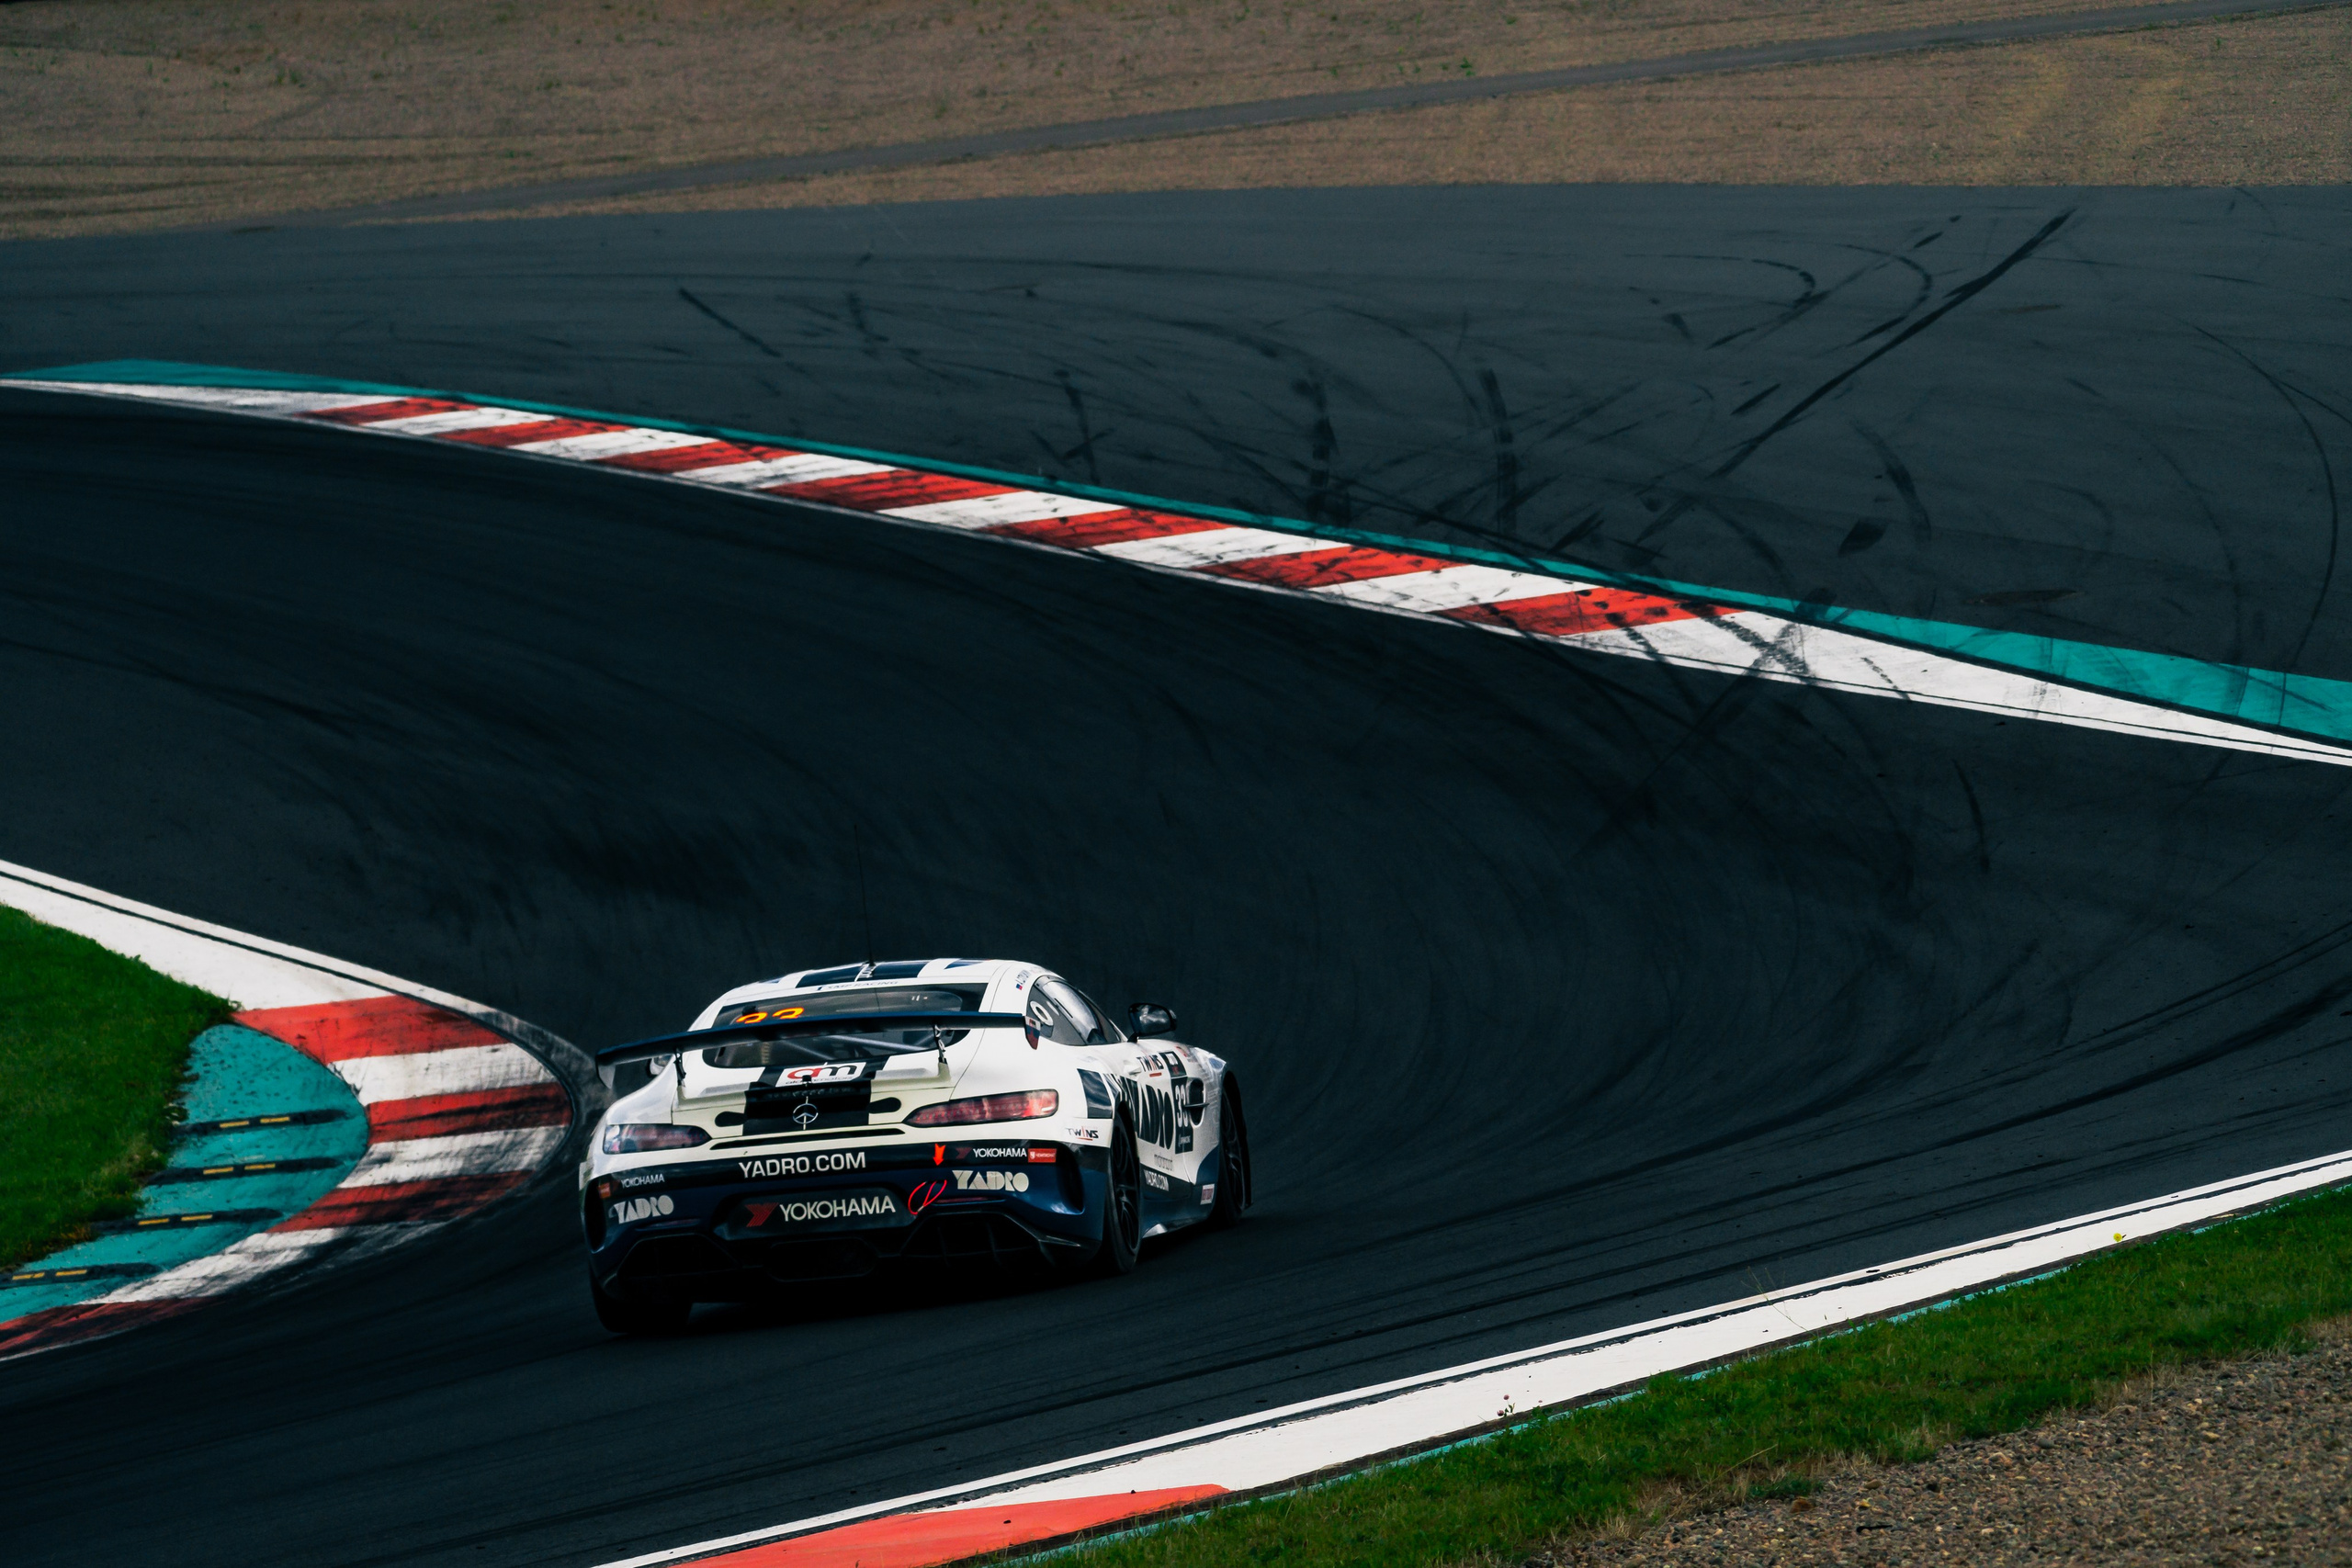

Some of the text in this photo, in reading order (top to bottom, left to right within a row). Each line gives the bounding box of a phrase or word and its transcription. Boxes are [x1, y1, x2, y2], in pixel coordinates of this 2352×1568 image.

[1175, 1084, 1190, 1128] 33
[1066, 1126, 1099, 1139] TWINS
[972, 1147, 1027, 1158] YOKOHAMA
[739, 1152, 866, 1179] YADRO.COM
[621, 1173, 665, 1189] YOKOHAMA
[952, 1169, 1029, 1192] YADRO
[613, 1194, 674, 1224] YADRO
[780, 1195, 896, 1222] YOKOHAMA
